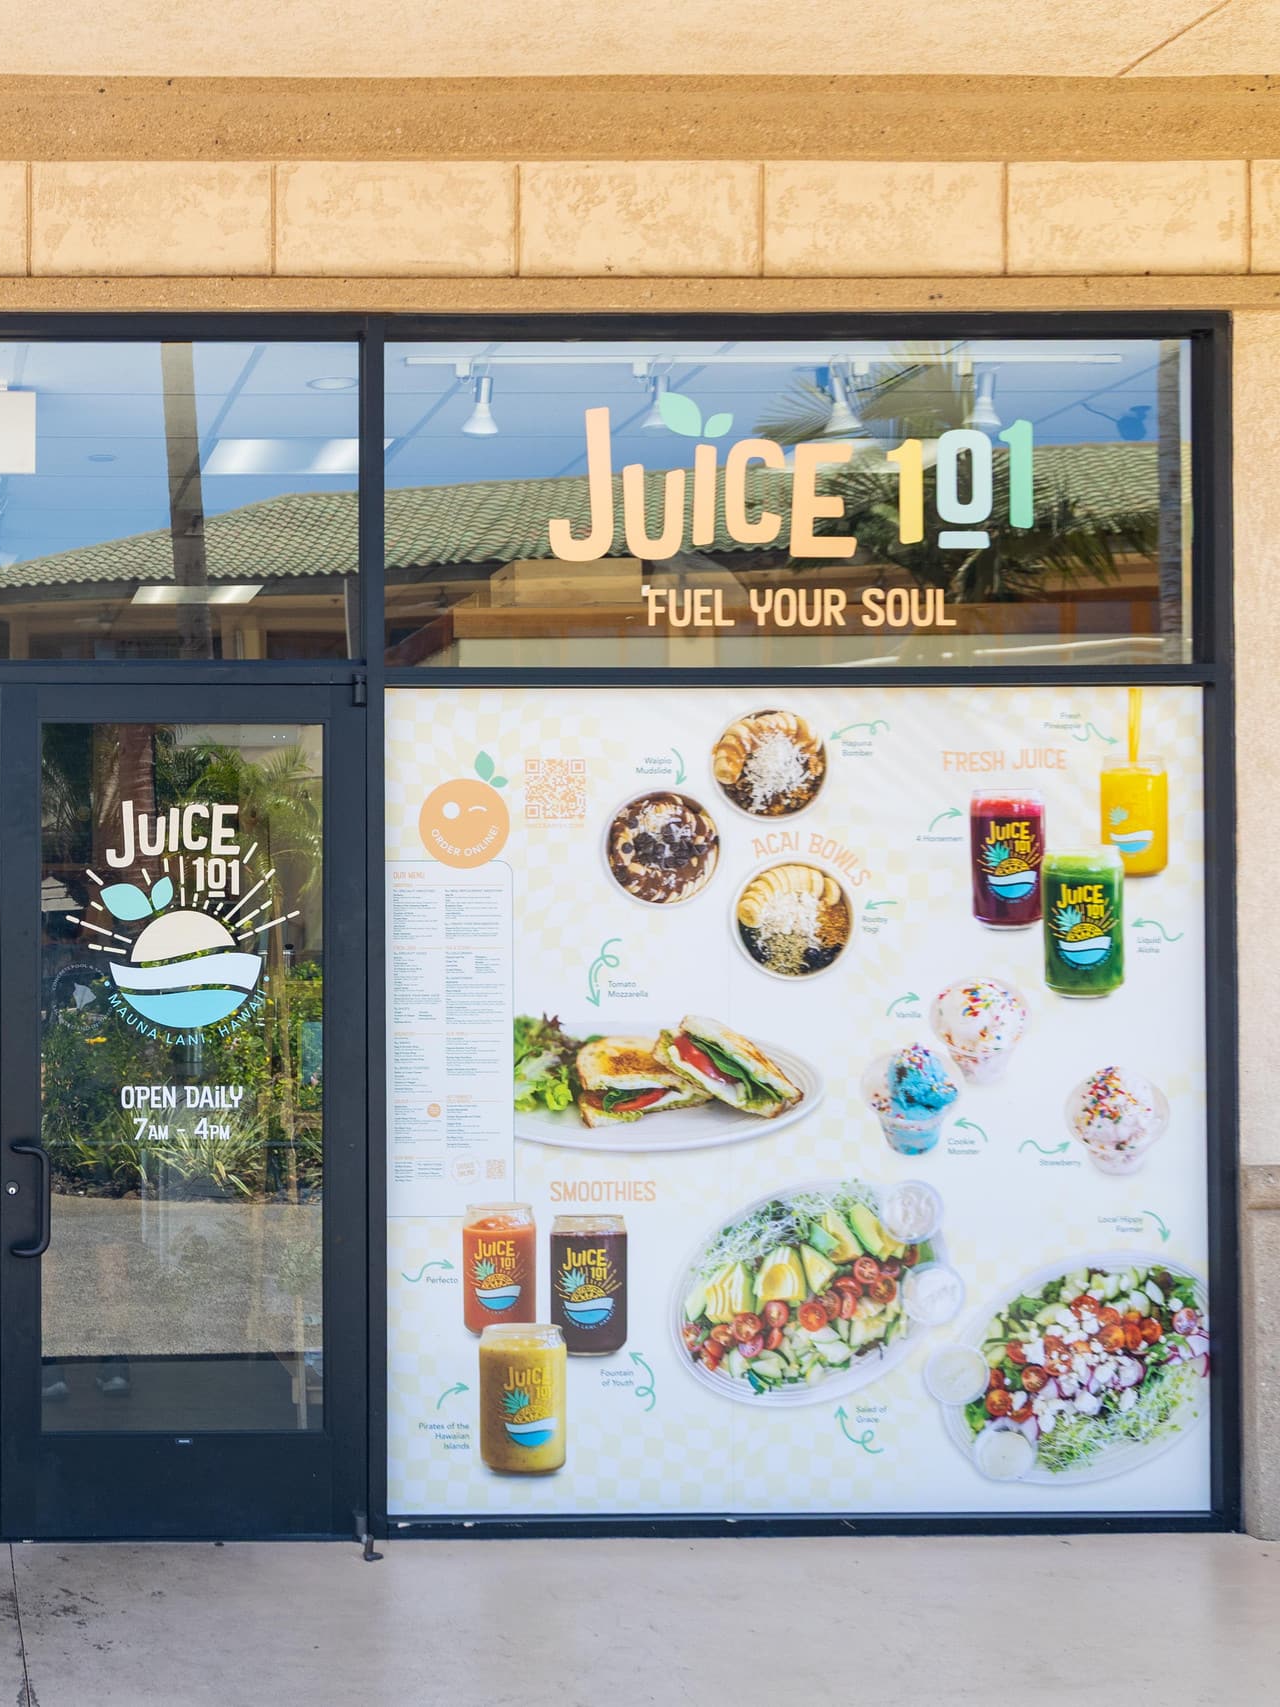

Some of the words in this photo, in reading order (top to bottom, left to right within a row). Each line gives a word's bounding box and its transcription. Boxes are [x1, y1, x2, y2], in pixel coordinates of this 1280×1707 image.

[549, 407, 858, 562] JUICE
[887, 419, 1034, 549] 101
[647, 589, 735, 628] FUEL
[749, 589, 845, 627] YOUR
[862, 589, 956, 627] SOUL
[635, 767, 672, 775] Mudslide
[941, 750, 1005, 772] FRESH
[1012, 748, 1069, 770] JUICE
[106, 800, 240, 868] JUICE
[432, 828, 461, 858] ORDER
[463, 825, 499, 858] ONLINE!
[985, 821, 1031, 844] JUICE
[751, 831, 800, 859] ACAI
[809, 832, 872, 888] BOWLS
[193, 857, 240, 897] 101
[1056, 883, 1105, 908] JUICE
[608, 980, 637, 988] Tomato
[608, 990, 649, 998] Mozzarella
[108, 993, 157, 1040] MAUNA
[166, 1034, 213, 1045] LANI,
[218, 988, 268, 1037] HAWAII
[121, 1086, 177, 1109] OPEN
[133, 1117, 169, 1140] 7AM
[194, 1117, 230, 1140] 4PM
[550, 1181, 657, 1202] SMOOTHIES
[474, 1238, 516, 1261] JUICE
[562, 1247, 607, 1270] JUICE
[501, 1257, 516, 1270] 101
[591, 1267, 607, 1280] 101
[426, 1276, 459, 1285] Perfecto
[600, 1369, 634, 1377] Fountain
[612, 1379, 634, 1387] Youth
[418, 1422, 443, 1430] Pirates
[445, 1422, 453, 1430] of
[455, 1422, 469, 1430] the
[435, 1432, 469, 1440] Hawaiian
[443, 1442, 469, 1450] Islands
